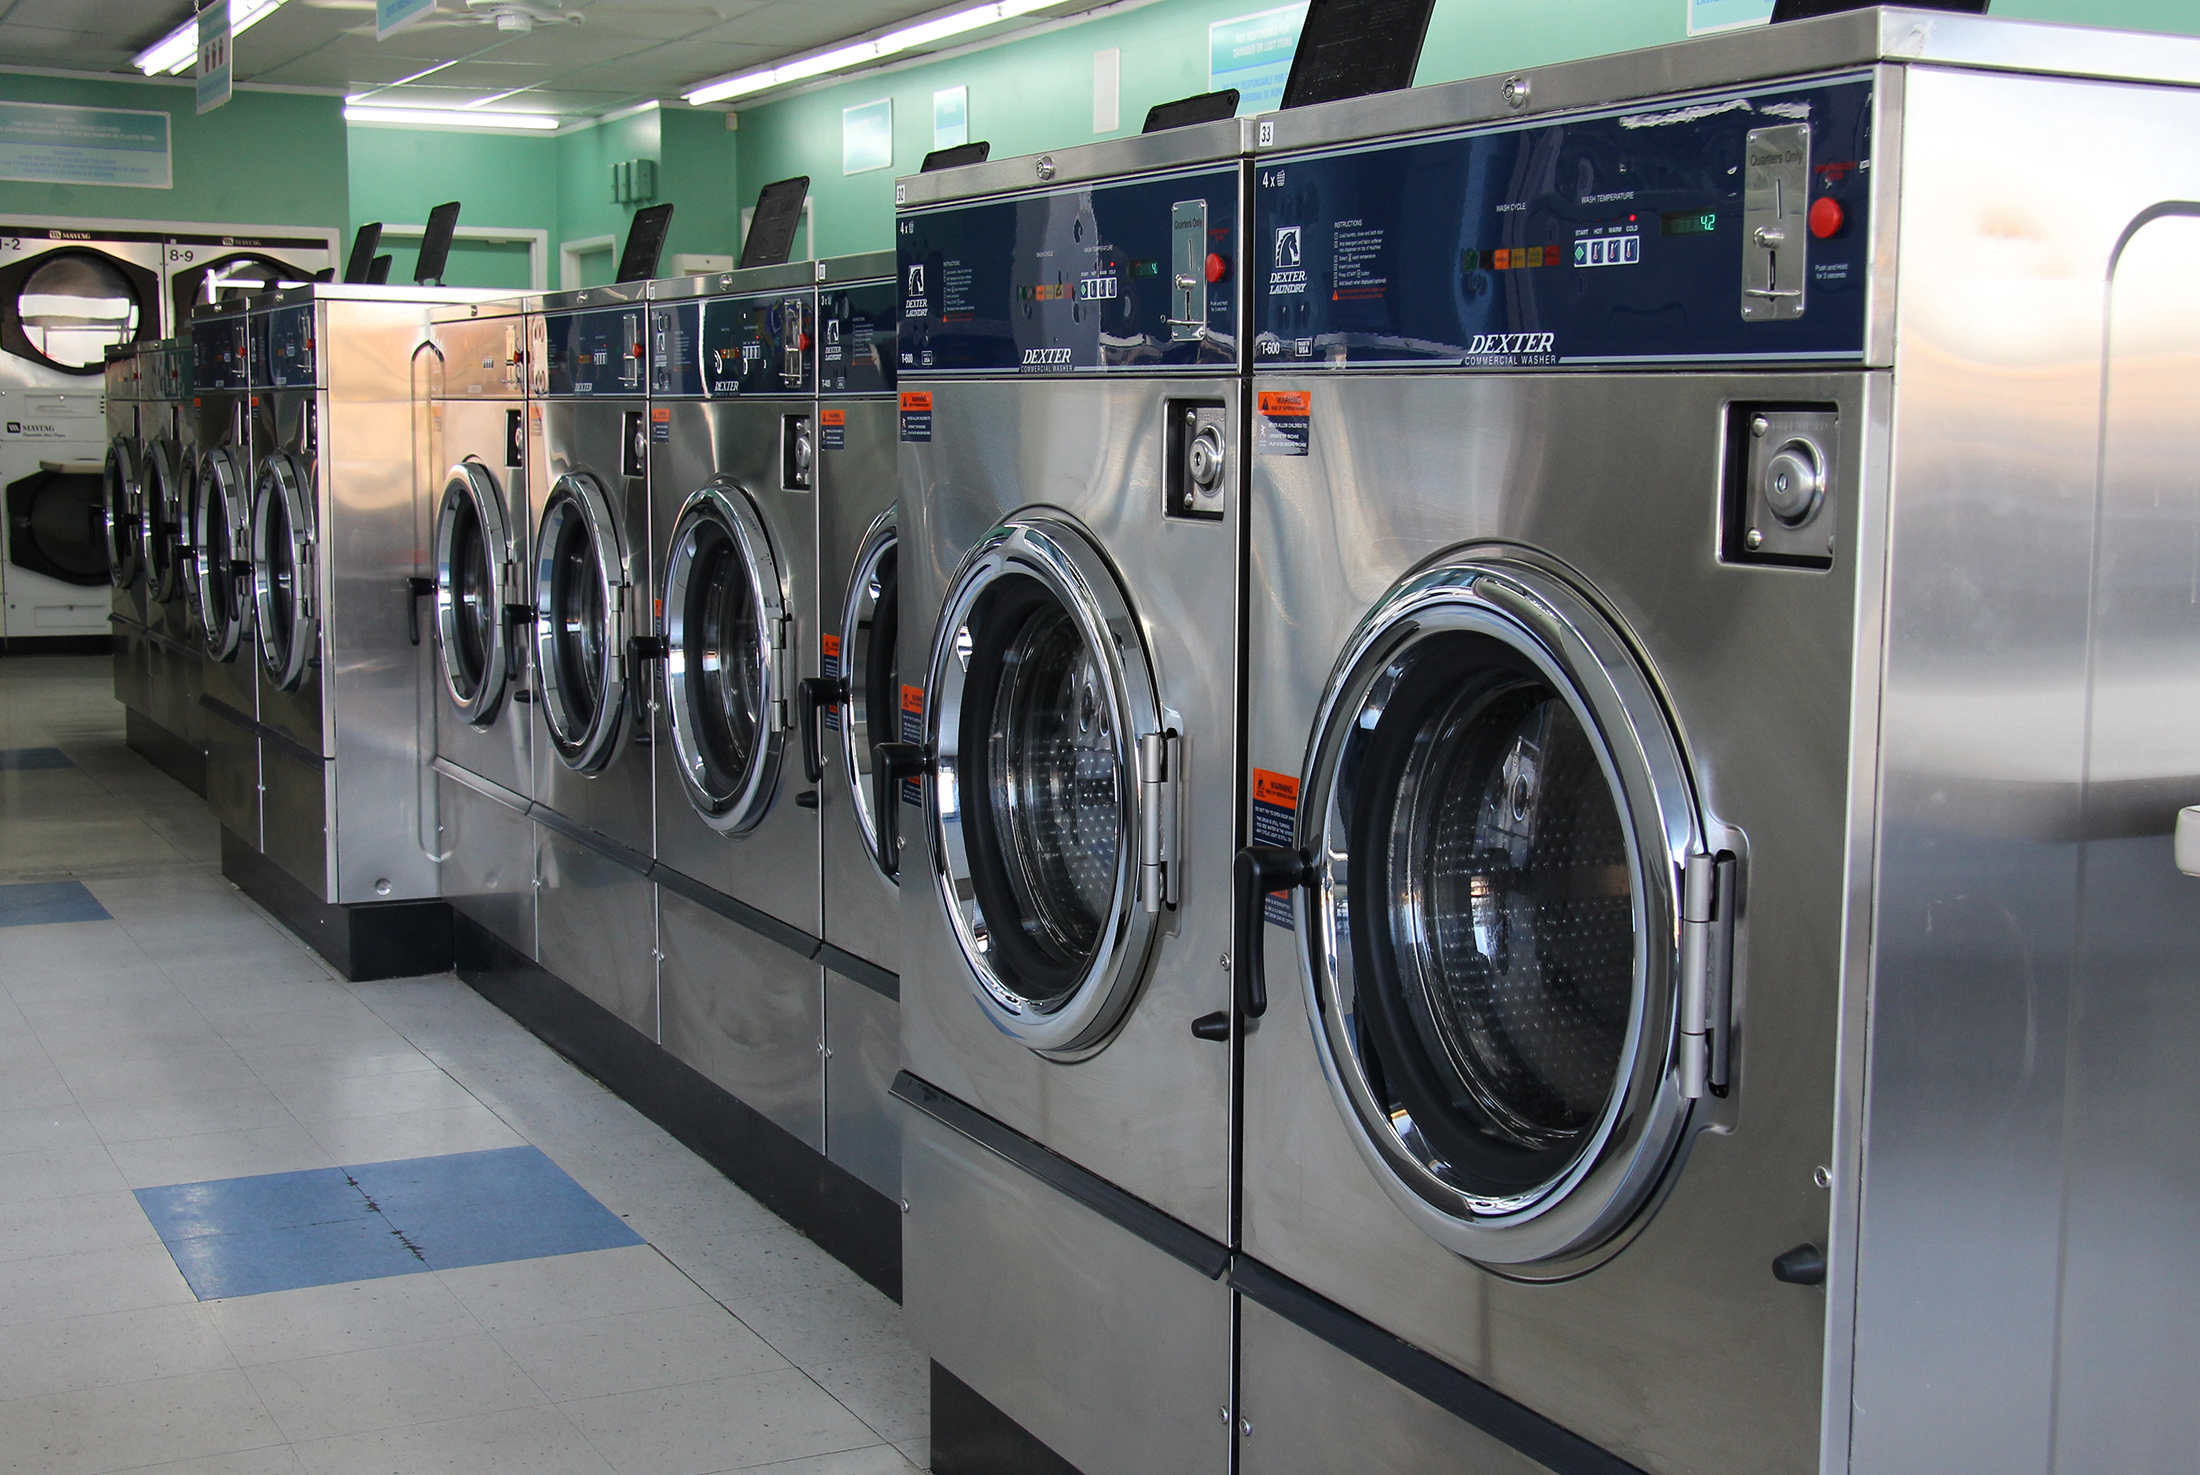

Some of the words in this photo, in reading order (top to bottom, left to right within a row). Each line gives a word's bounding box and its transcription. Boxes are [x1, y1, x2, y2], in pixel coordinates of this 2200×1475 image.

[1261, 126, 1271, 142] 33
[1751, 153, 1784, 166] Quarters
[1784, 151, 1803, 165] Only
[1581, 195, 1596, 203] WASH
[1597, 191, 1635, 202] TEMPERATURE
[1496, 204, 1510, 212] WASH
[1510, 203, 1527, 212] CYCLE
[1174, 220, 1192, 229] Quarters
[1192, 218, 1202, 229] Only
[1334, 219, 1363, 228] INSTRUCTIONS
[170, 250, 194, 262] 8-9
[1269, 271, 1306, 284] DEXTER
[1269, 283, 1307, 295] LAUNDRY
[905, 299, 928, 309] DEXTER
[1261, 341, 1281, 355] T-600
[1467, 333, 1555, 354] DEXTER
[1022, 348, 1072, 364] DEXTER
[1298, 346, 1309, 354] USA
[1465, 356, 1518, 366] COMMERCIAL
[1521, 355, 1556, 365] WASHER
[1020, 365, 1051, 373] COMMERCIAL
[1052, 364, 1073, 372] WASHER
[574, 383, 593, 392] DEXTER
[714, 381, 740, 392] DEXTER
[1270, 781, 1293, 794] WARNING
